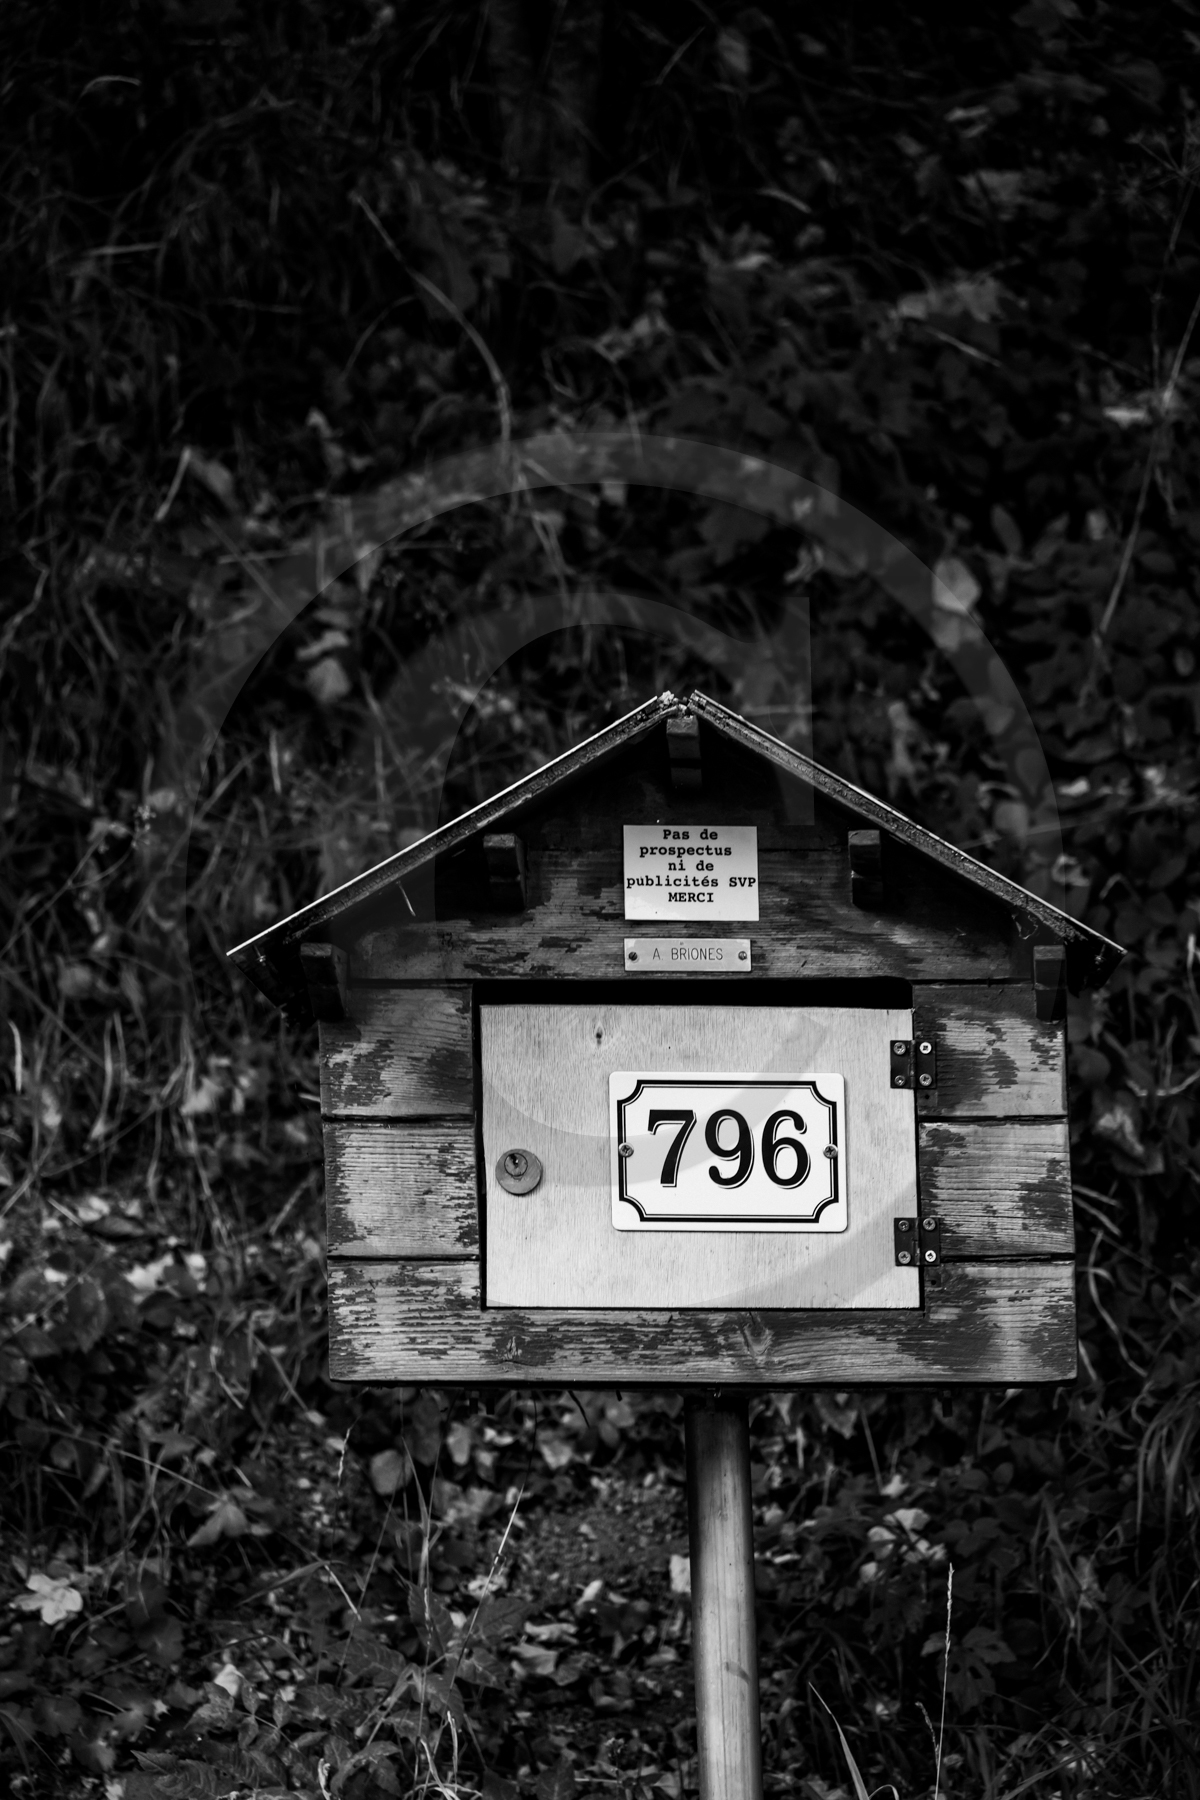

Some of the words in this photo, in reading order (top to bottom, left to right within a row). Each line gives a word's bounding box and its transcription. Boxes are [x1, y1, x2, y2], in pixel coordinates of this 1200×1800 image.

[663, 829, 690, 840] Pas
[700, 828, 718, 840] de
[639, 845, 732, 858] prospectus
[668, 859, 686, 871] ni
[696, 860, 714, 871] de
[626, 875, 719, 889] publicités
[729, 877, 757, 888] SVP
[668, 892, 714, 903] MERCI
[671, 948, 723, 960] BRIONES
[647, 1109, 811, 1189] 796
